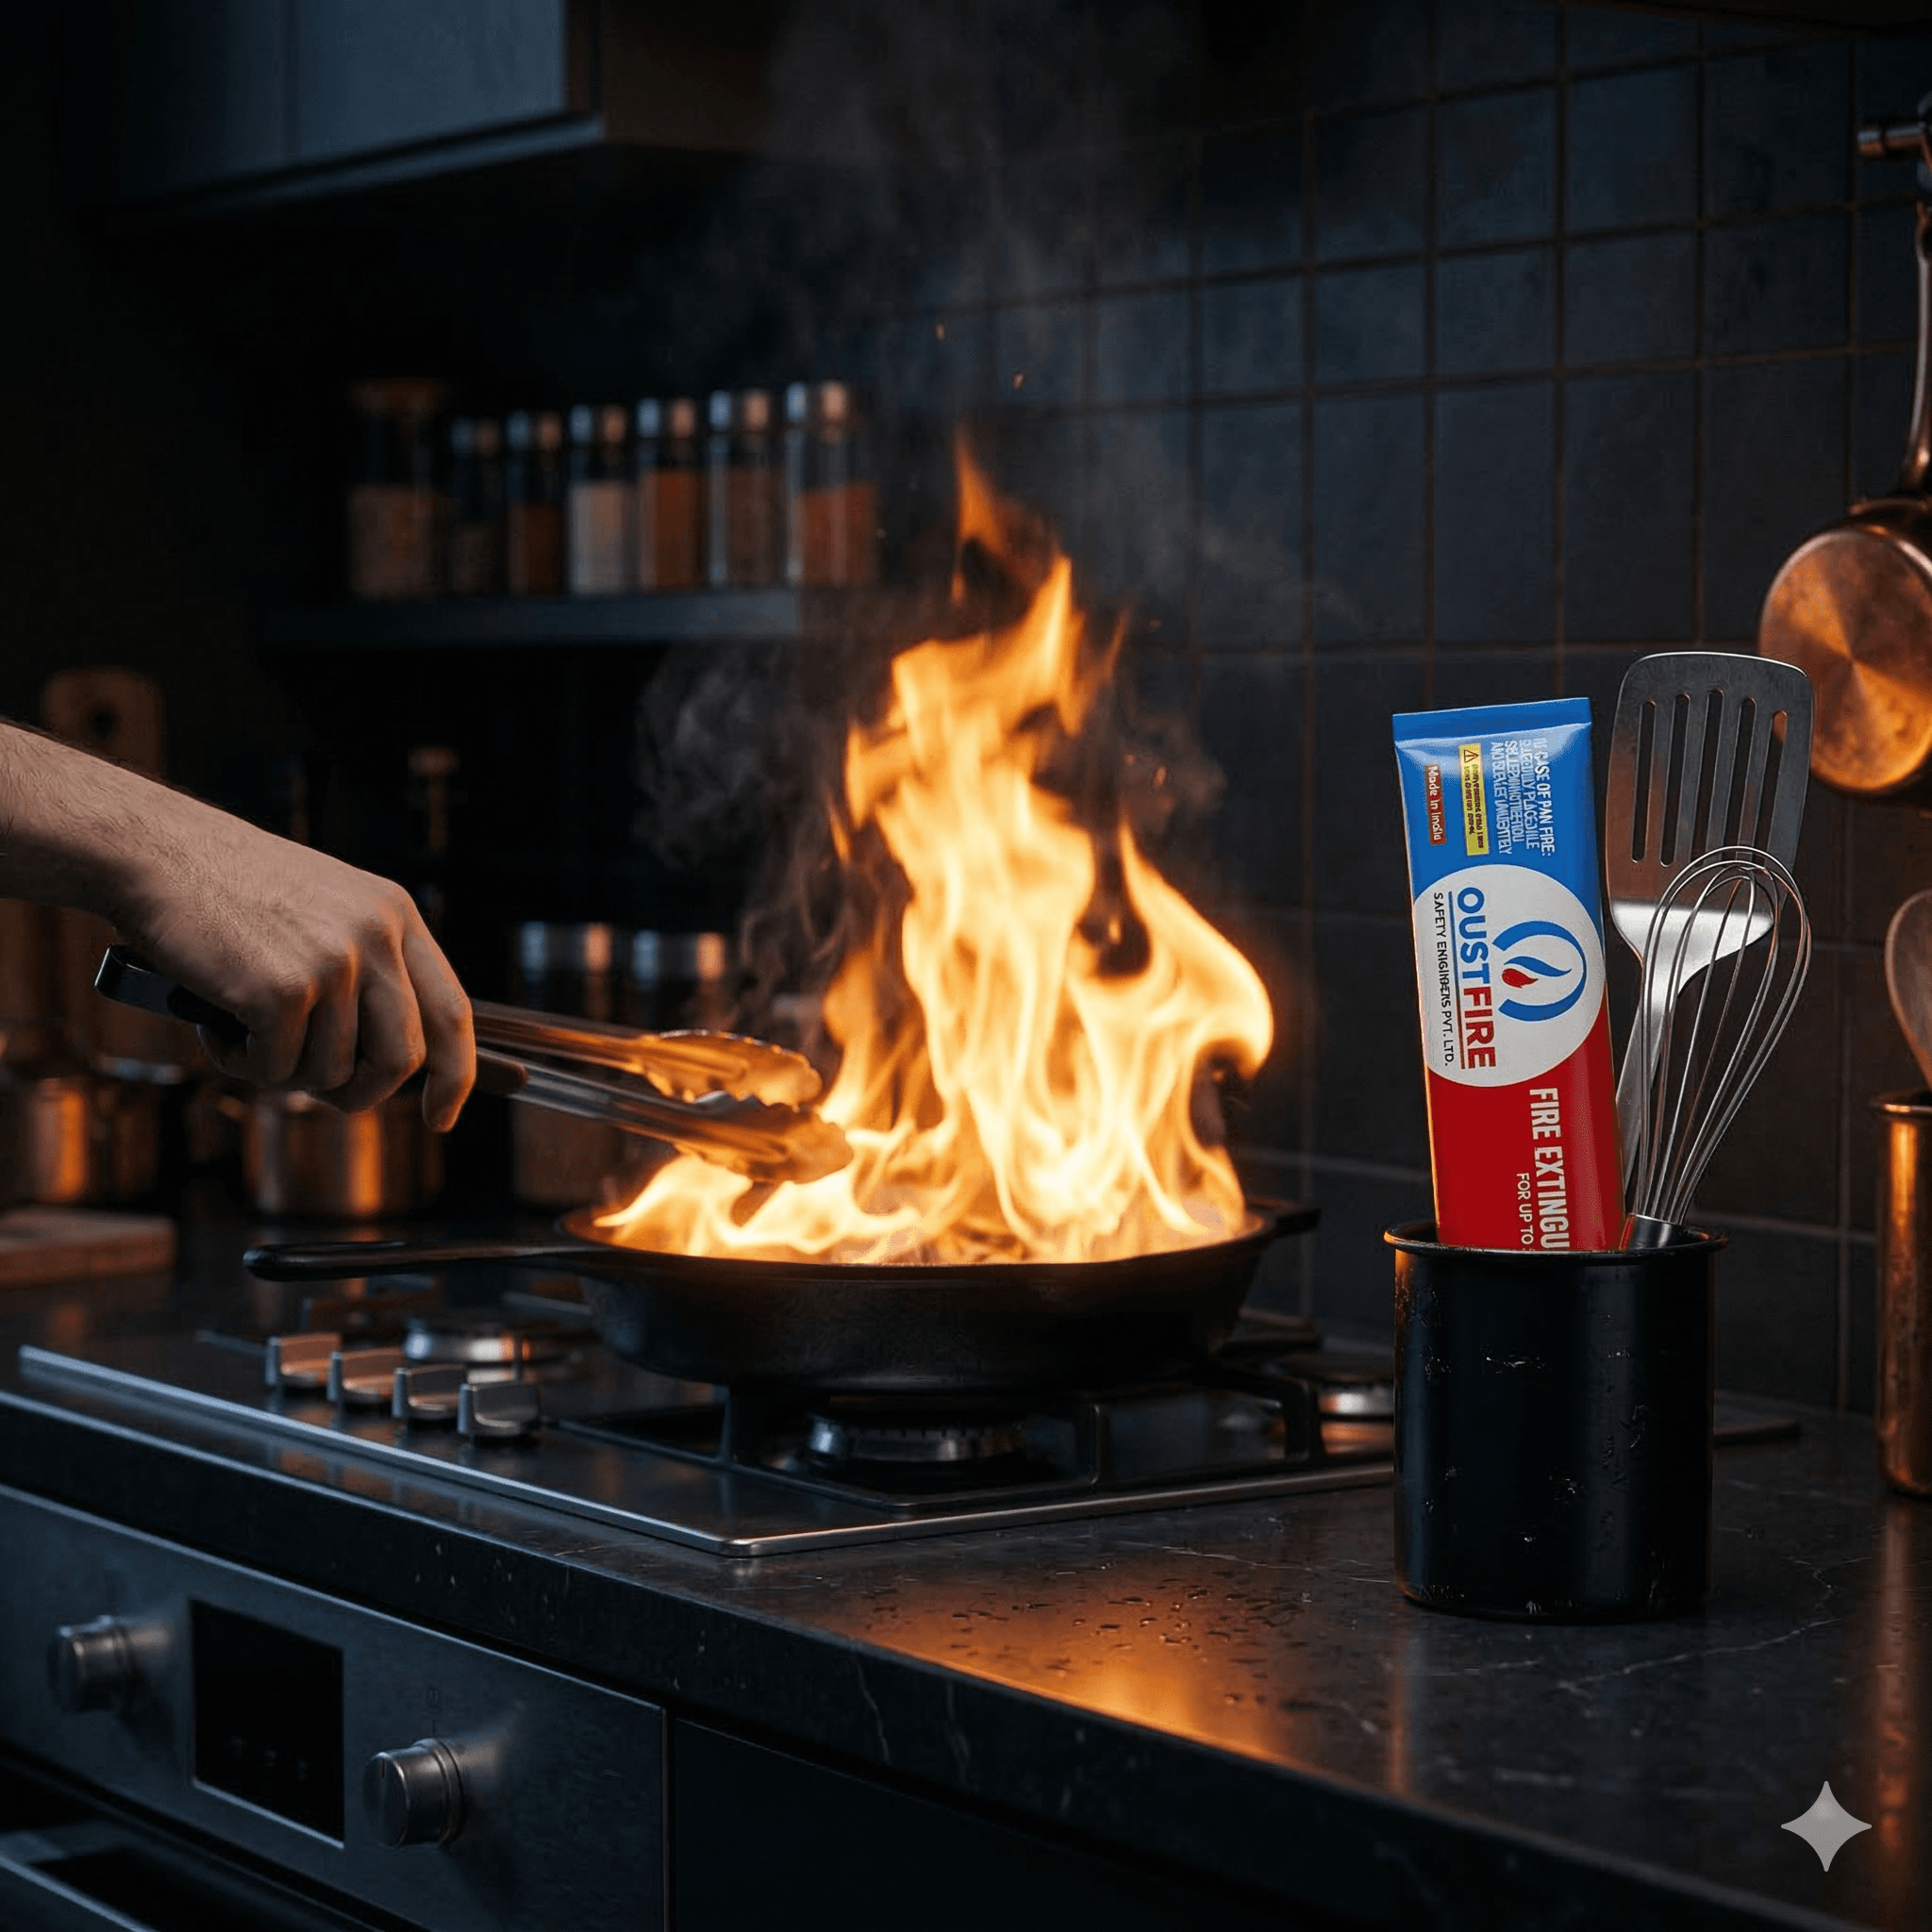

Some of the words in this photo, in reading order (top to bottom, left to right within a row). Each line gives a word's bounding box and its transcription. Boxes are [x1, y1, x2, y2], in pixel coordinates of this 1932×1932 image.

[1534, 751, 1550, 781] CASE
[1427, 765, 1440, 796] Made
[1536, 783, 1552, 798] OF
[1538, 800, 1555, 824] PAN
[1539, 826, 1556, 856] FIRE:
[1433, 892, 1446, 938] SAFETY
[1457, 887, 1496, 1069] OUSTFIRE
[1441, 1010, 1454, 1038] PVT.
[1443, 1040, 1455, 1067] LTD.
[1529, 1088, 1561, 1140] FIRE
[1516, 1173, 1531, 1200] FOR
[1519, 1203, 1533, 1223] UP
[1521, 1224, 1534, 1244] TO
